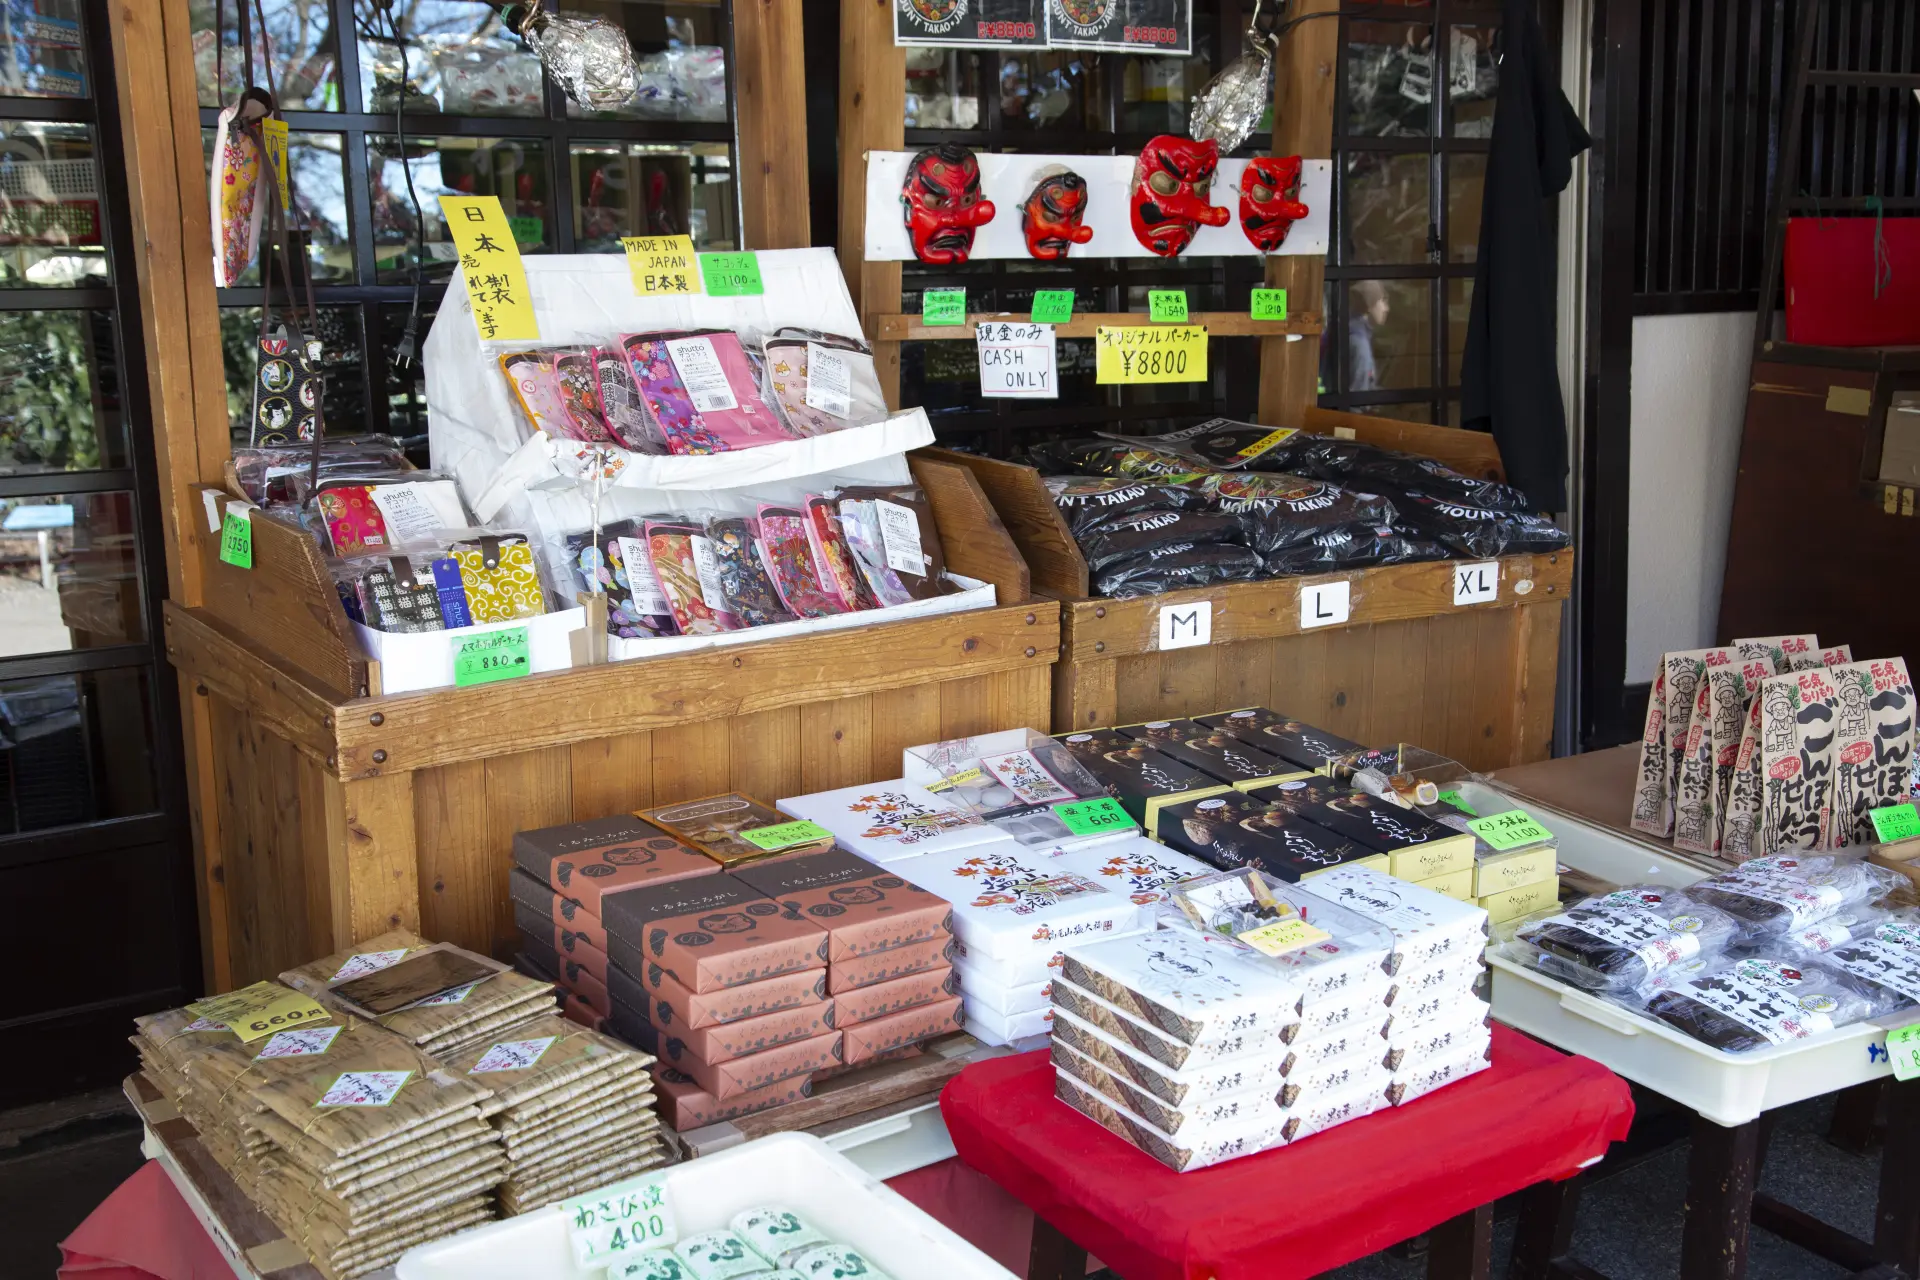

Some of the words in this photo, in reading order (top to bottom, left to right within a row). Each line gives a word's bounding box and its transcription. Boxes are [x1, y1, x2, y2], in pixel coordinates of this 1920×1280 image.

[625, 239, 658, 253] MADE
[662, 239, 678, 251] IN
[648, 256, 686, 269] JAPAN
[712, 257, 750, 269] サコッシュ
[644, 273, 689, 292] 日本製
[461, 253, 499, 339] 売れています
[979, 323, 1043, 342] 現金のみ
[1103, 329, 1200, 346] オリジナルパーカー
[676, 344, 705, 354] shutto
[815, 349, 842, 365] shutto
[984, 349, 1024, 366] CASH
[1122, 350, 1187, 376] ¥8800
[1005, 371, 1048, 388] ONLY
[383, 489, 414, 500] shutto
[1095, 487, 1145, 506] TAKAO
[884, 507, 908, 519] shutto
[1286, 498, 1331, 512] TAKAO
[1433, 503, 1507, 522] MOUNT
[1129, 513, 1180, 532] TAKAO
[1457, 569, 1491, 597] XL
[1315, 592, 1334, 620] L
[1170, 610, 1198, 640] M
[1781, 637, 1810, 654] 元気
[482, 655, 509, 669] 880
[1705, 650, 1731, 667] 元気
[1823, 649, 1848, 667] 元気
[1743, 662, 1768, 680] 元気
[1870, 660, 1899, 678] 元気
[1798, 672, 1825, 690] 元気
[1874, 674, 1910, 691] もりもり
[1801, 686, 1834, 703] もりもり
[1643, 743, 1661, 781] せんべい
[1683, 758, 1701, 799] せんべい
[1796, 696, 1839, 851] ごんぼう
[1734, 770, 1752, 811] せんべい
[1063, 802, 1115, 816] 塩大福
[1088, 813, 1121, 826] 660
[558, 828, 640, 848] くるみころがし
[1895, 824, 1913, 838] 550
[988, 854, 1049, 882] 高尾山
[781, 867, 864, 888] くるみころがし
[650, 892, 738, 912] くるみころがし
[249, 1008, 323, 1032] 660円
[573, 1183, 666, 1229] わさび漬
[610, 1213, 664, 1251] 400
